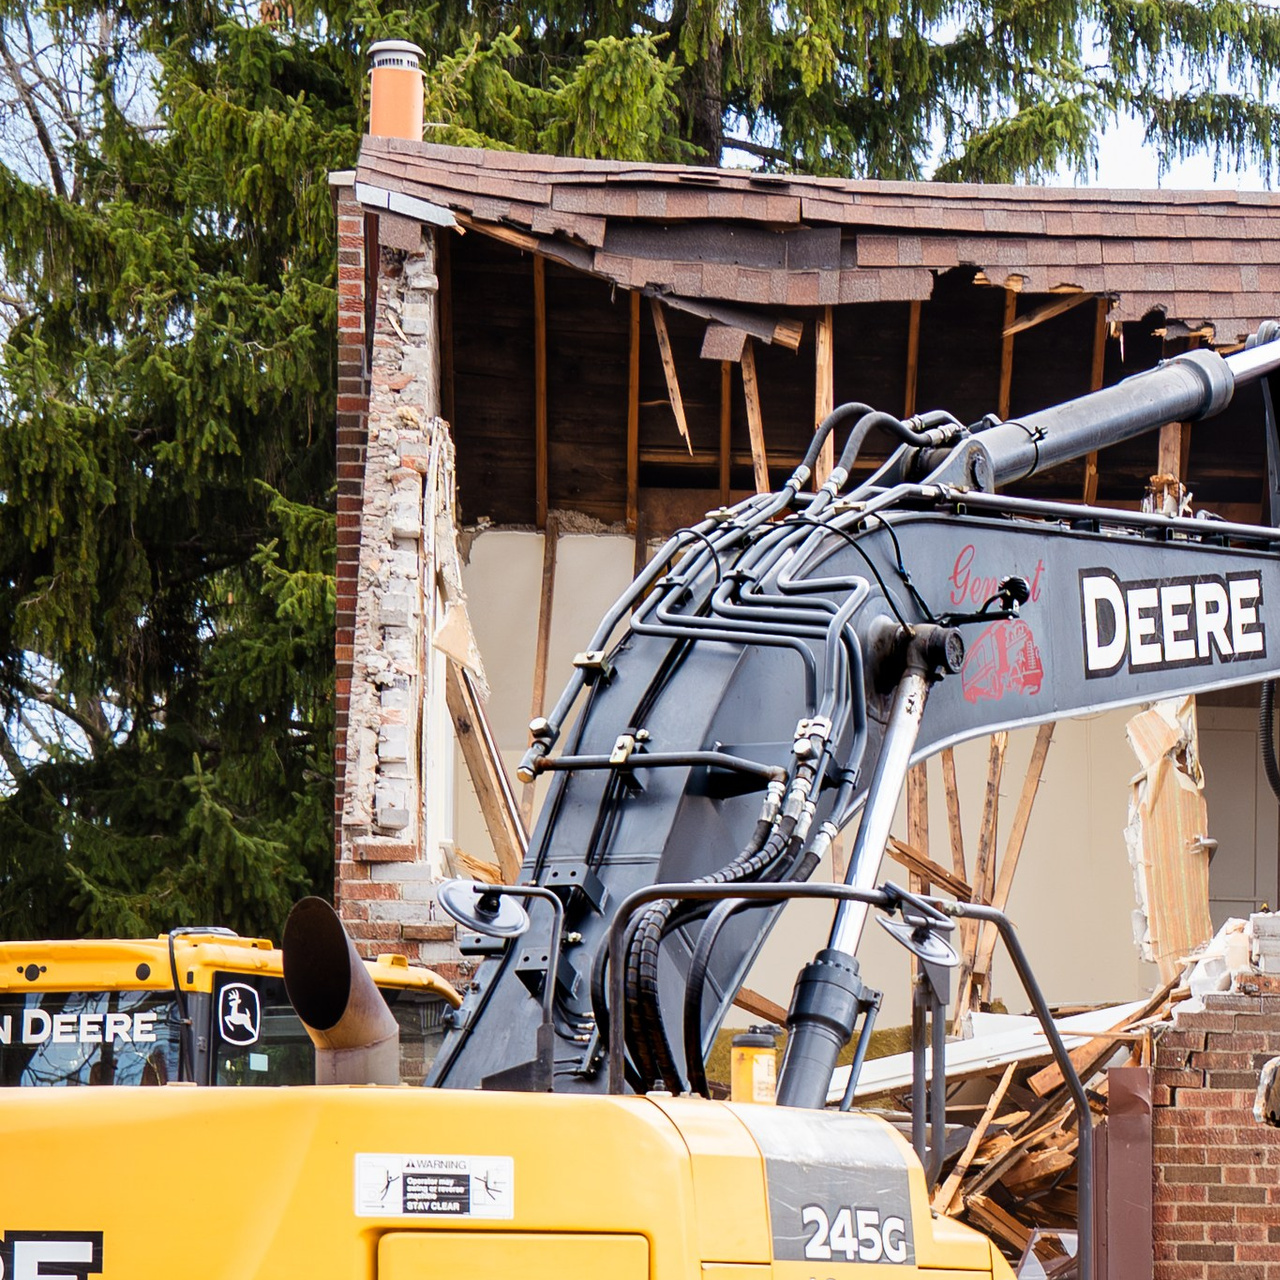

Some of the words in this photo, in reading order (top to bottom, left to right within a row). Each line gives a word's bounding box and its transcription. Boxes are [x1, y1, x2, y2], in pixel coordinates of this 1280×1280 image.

[1082, 576, 1264, 671] DEERE
[22, 1008, 158, 1044] DEERE
[416, 1159, 467, 1170] WARNING
[406, 1201, 430, 1211] STAY
[430, 1202, 461, 1212] CLEAR
[801, 1205, 907, 1264] 245G
